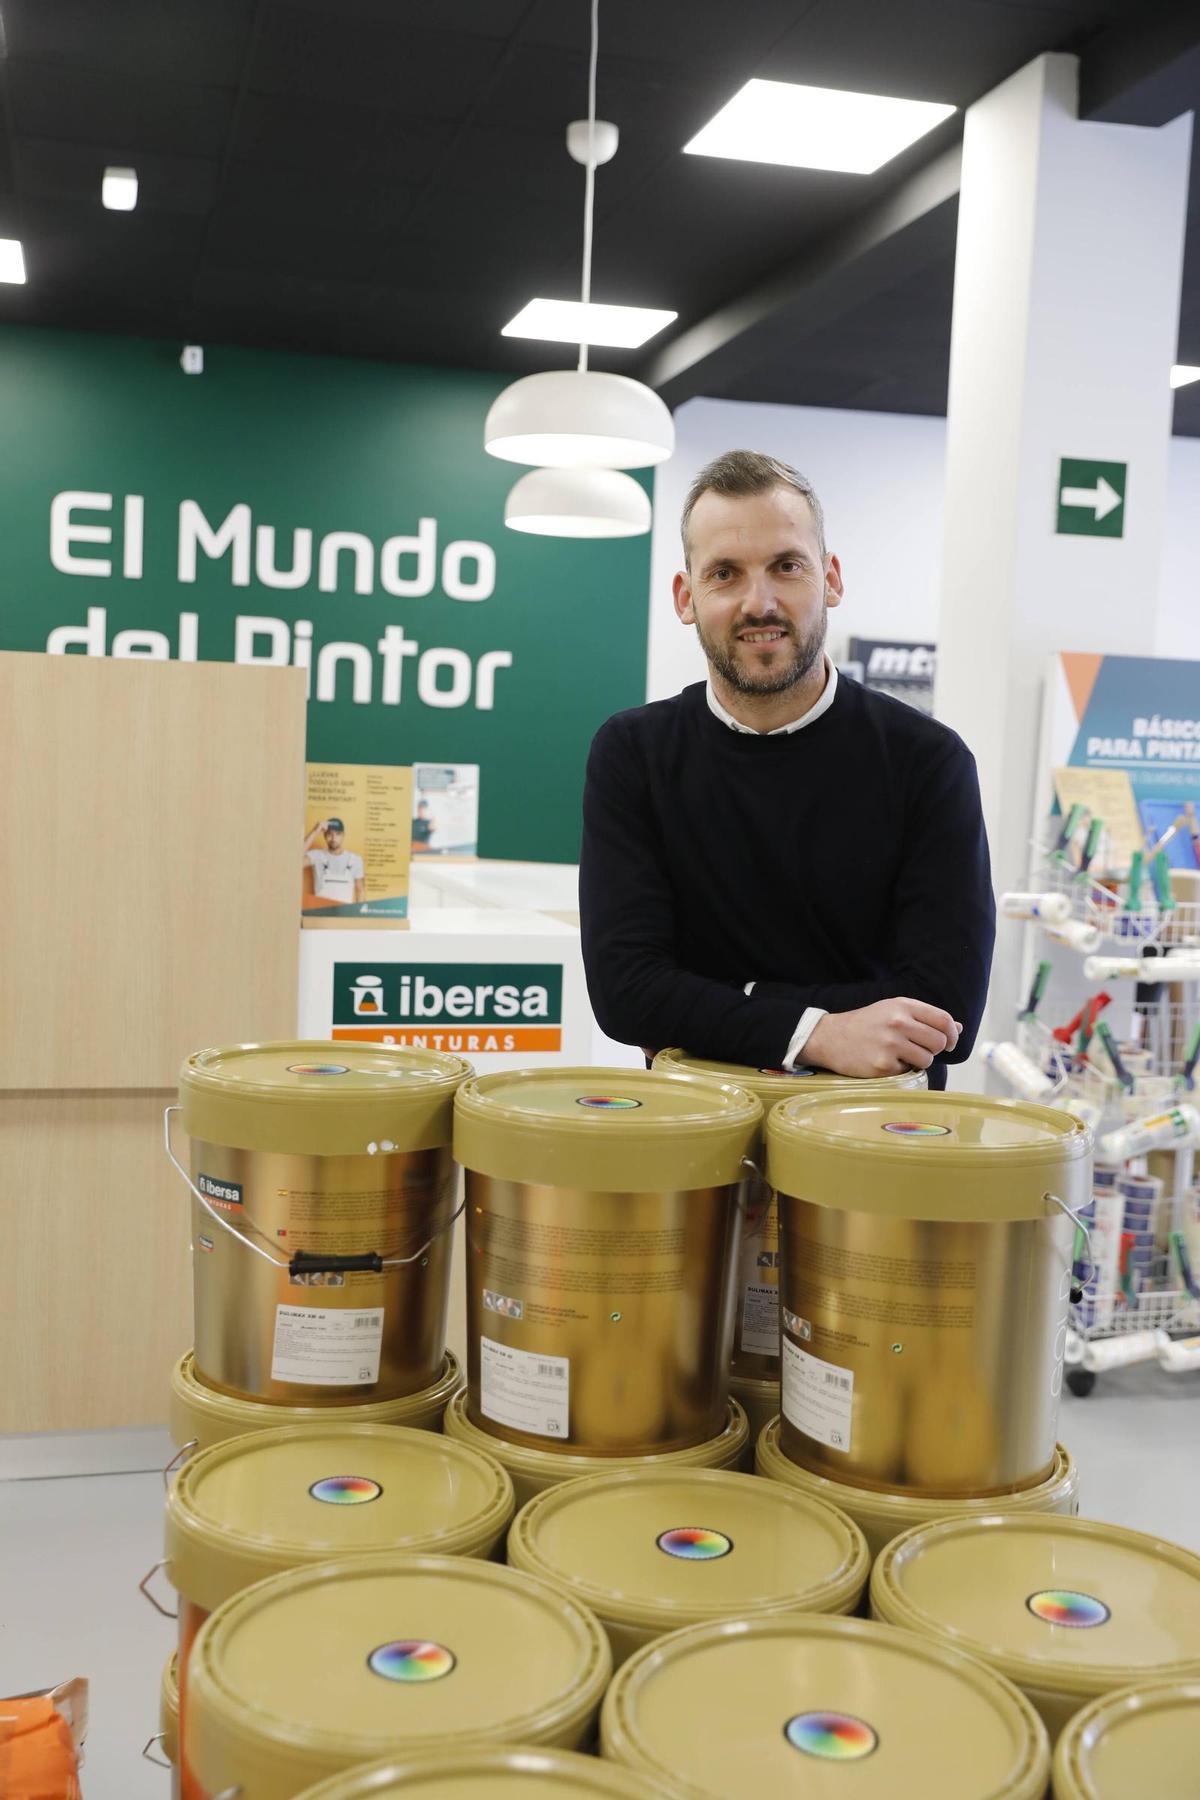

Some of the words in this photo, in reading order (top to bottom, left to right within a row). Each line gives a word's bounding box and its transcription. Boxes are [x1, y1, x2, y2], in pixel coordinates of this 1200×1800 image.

[50, 490, 144, 579] El
[178, 499, 496, 602] Mundo
[235, 615, 512, 710] Pintor
[1087, 737, 1144, 758] PARA
[399, 975, 549, 1017] ibersa
[383, 1034, 516, 1051] PINTURAS
[206, 1179, 240, 1202] ibersa
